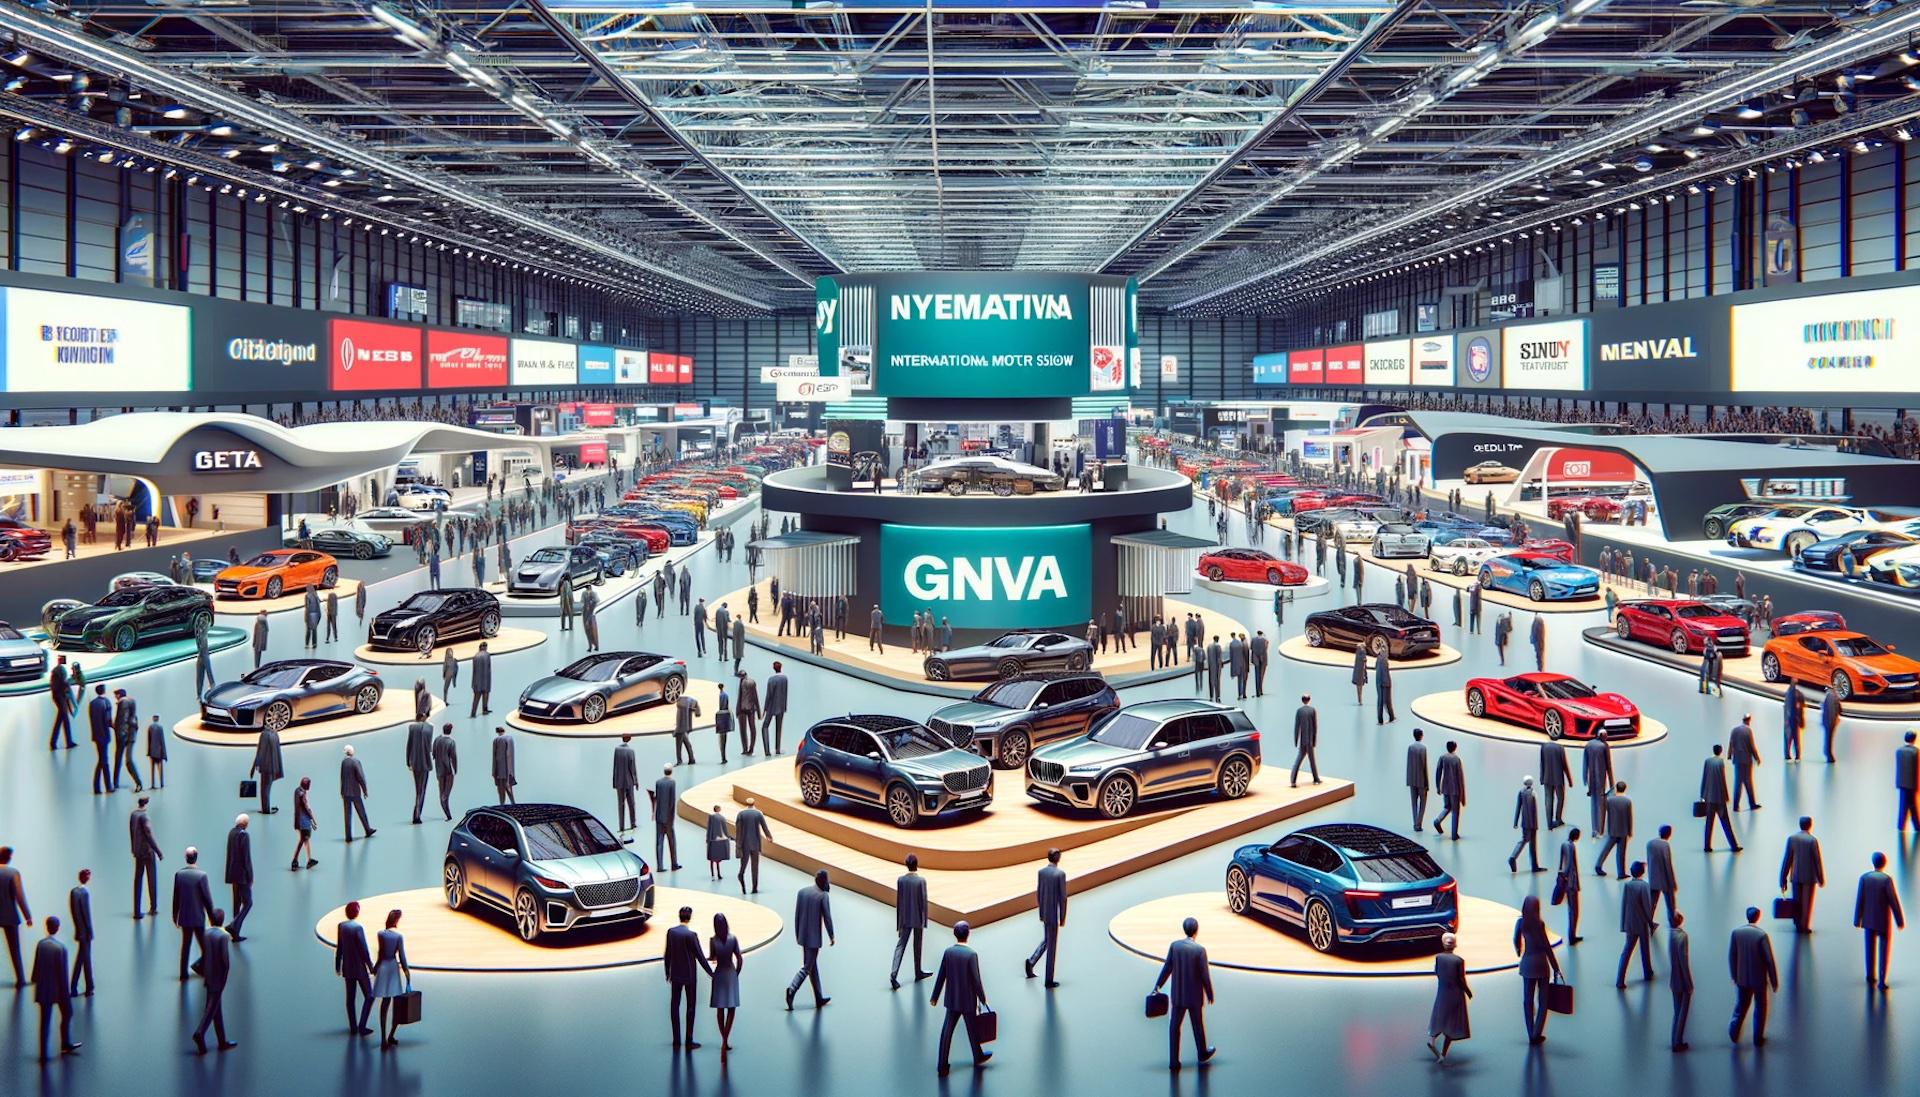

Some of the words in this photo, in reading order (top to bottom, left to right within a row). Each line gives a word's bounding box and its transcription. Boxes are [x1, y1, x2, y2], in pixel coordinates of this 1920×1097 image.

[1601, 336, 1698, 361] MENVAL
[195, 450, 263, 470] GETA
[903, 554, 1068, 601] GNVA
